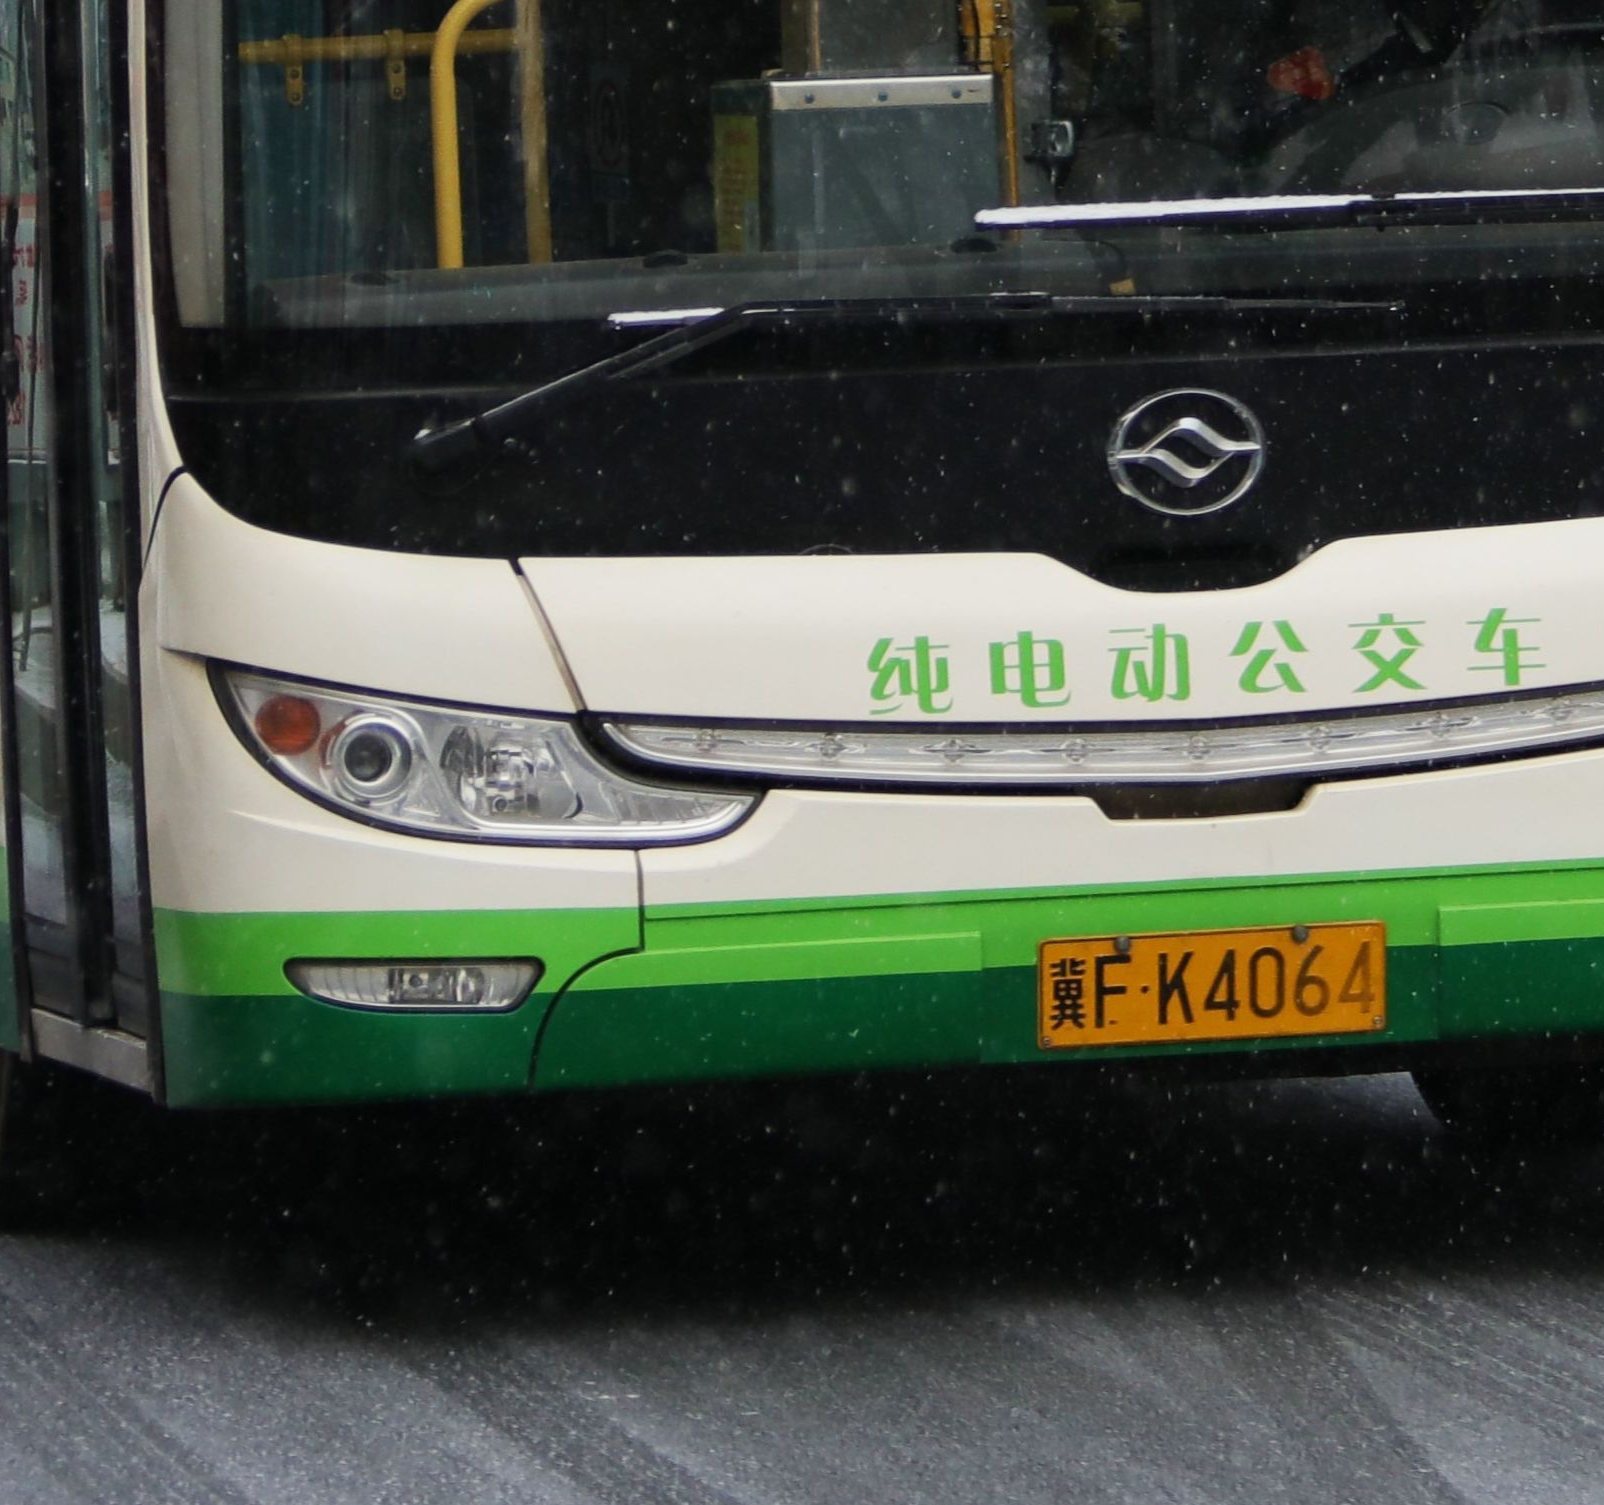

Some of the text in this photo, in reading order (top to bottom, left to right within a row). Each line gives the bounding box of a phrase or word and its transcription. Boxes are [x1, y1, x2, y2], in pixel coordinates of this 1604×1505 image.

[867, 607, 1547, 715] 纯电动公交车
